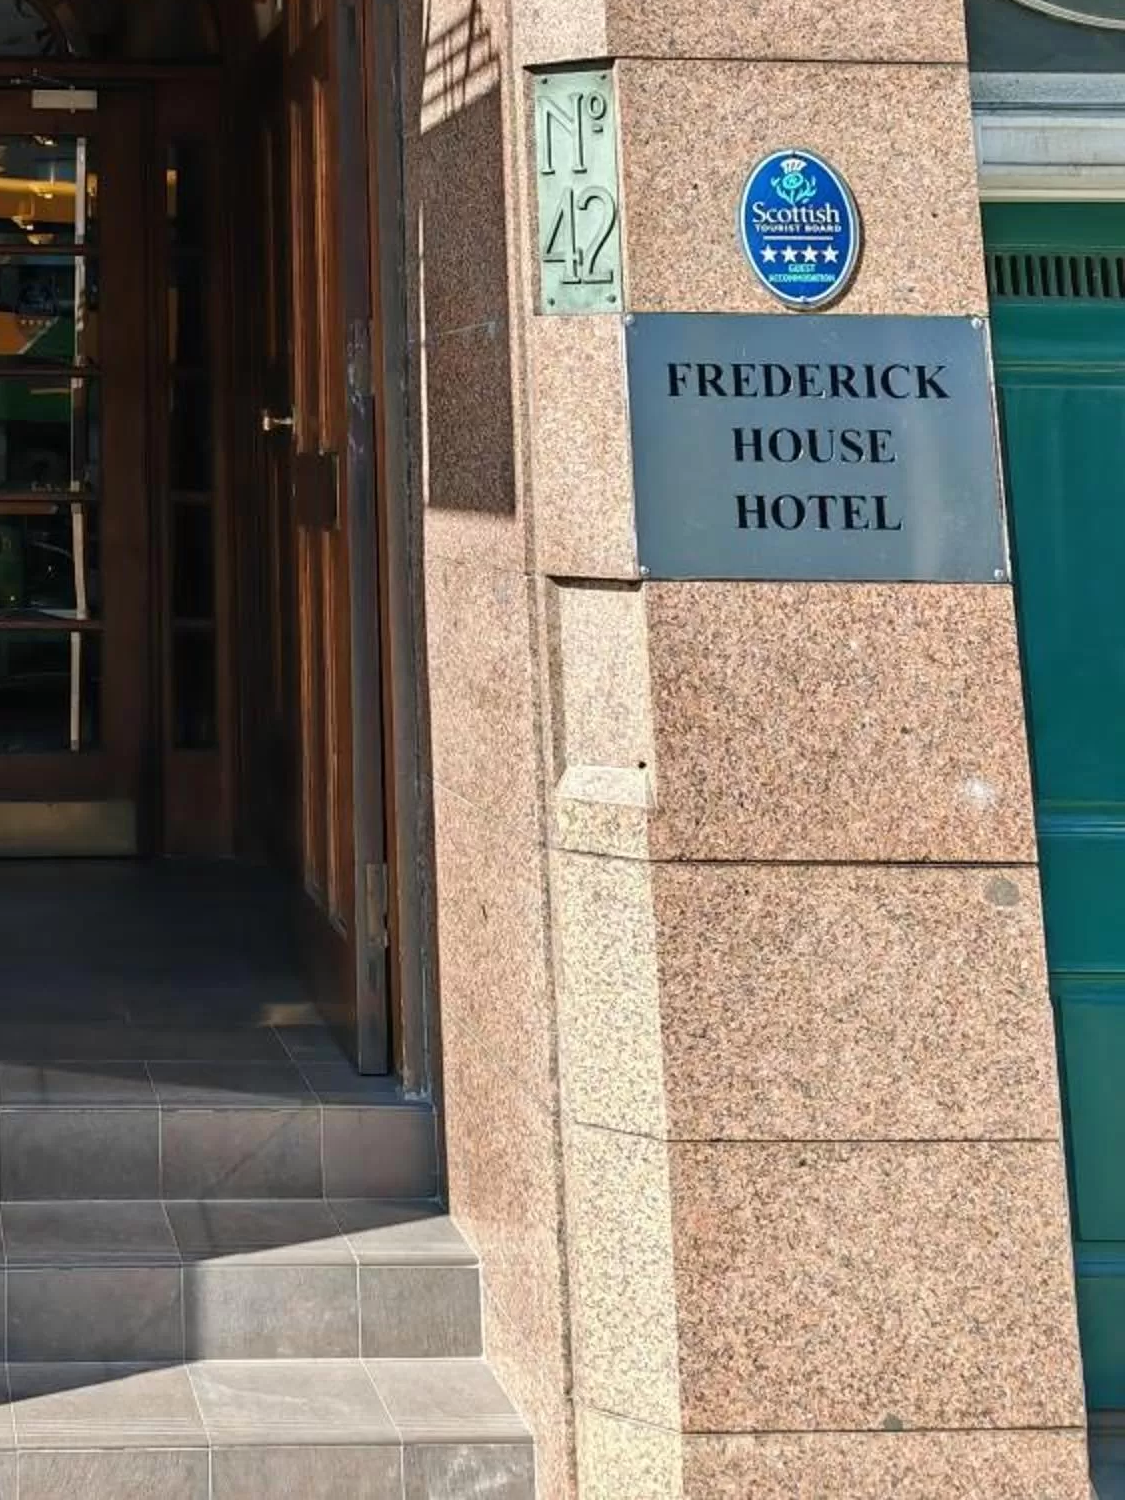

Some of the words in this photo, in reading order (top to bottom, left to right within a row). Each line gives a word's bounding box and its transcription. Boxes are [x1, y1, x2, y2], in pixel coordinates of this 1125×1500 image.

[751, 201, 841, 223] Scottish
[755, 224, 801, 233] TOURIST
[804, 224, 842, 233] BOARD
[542, 186, 616, 285] 42
[667, 363, 951, 399] FREDERICK
[732, 427, 897, 464] HOUSE
[735, 494, 903, 531] HOTEL
